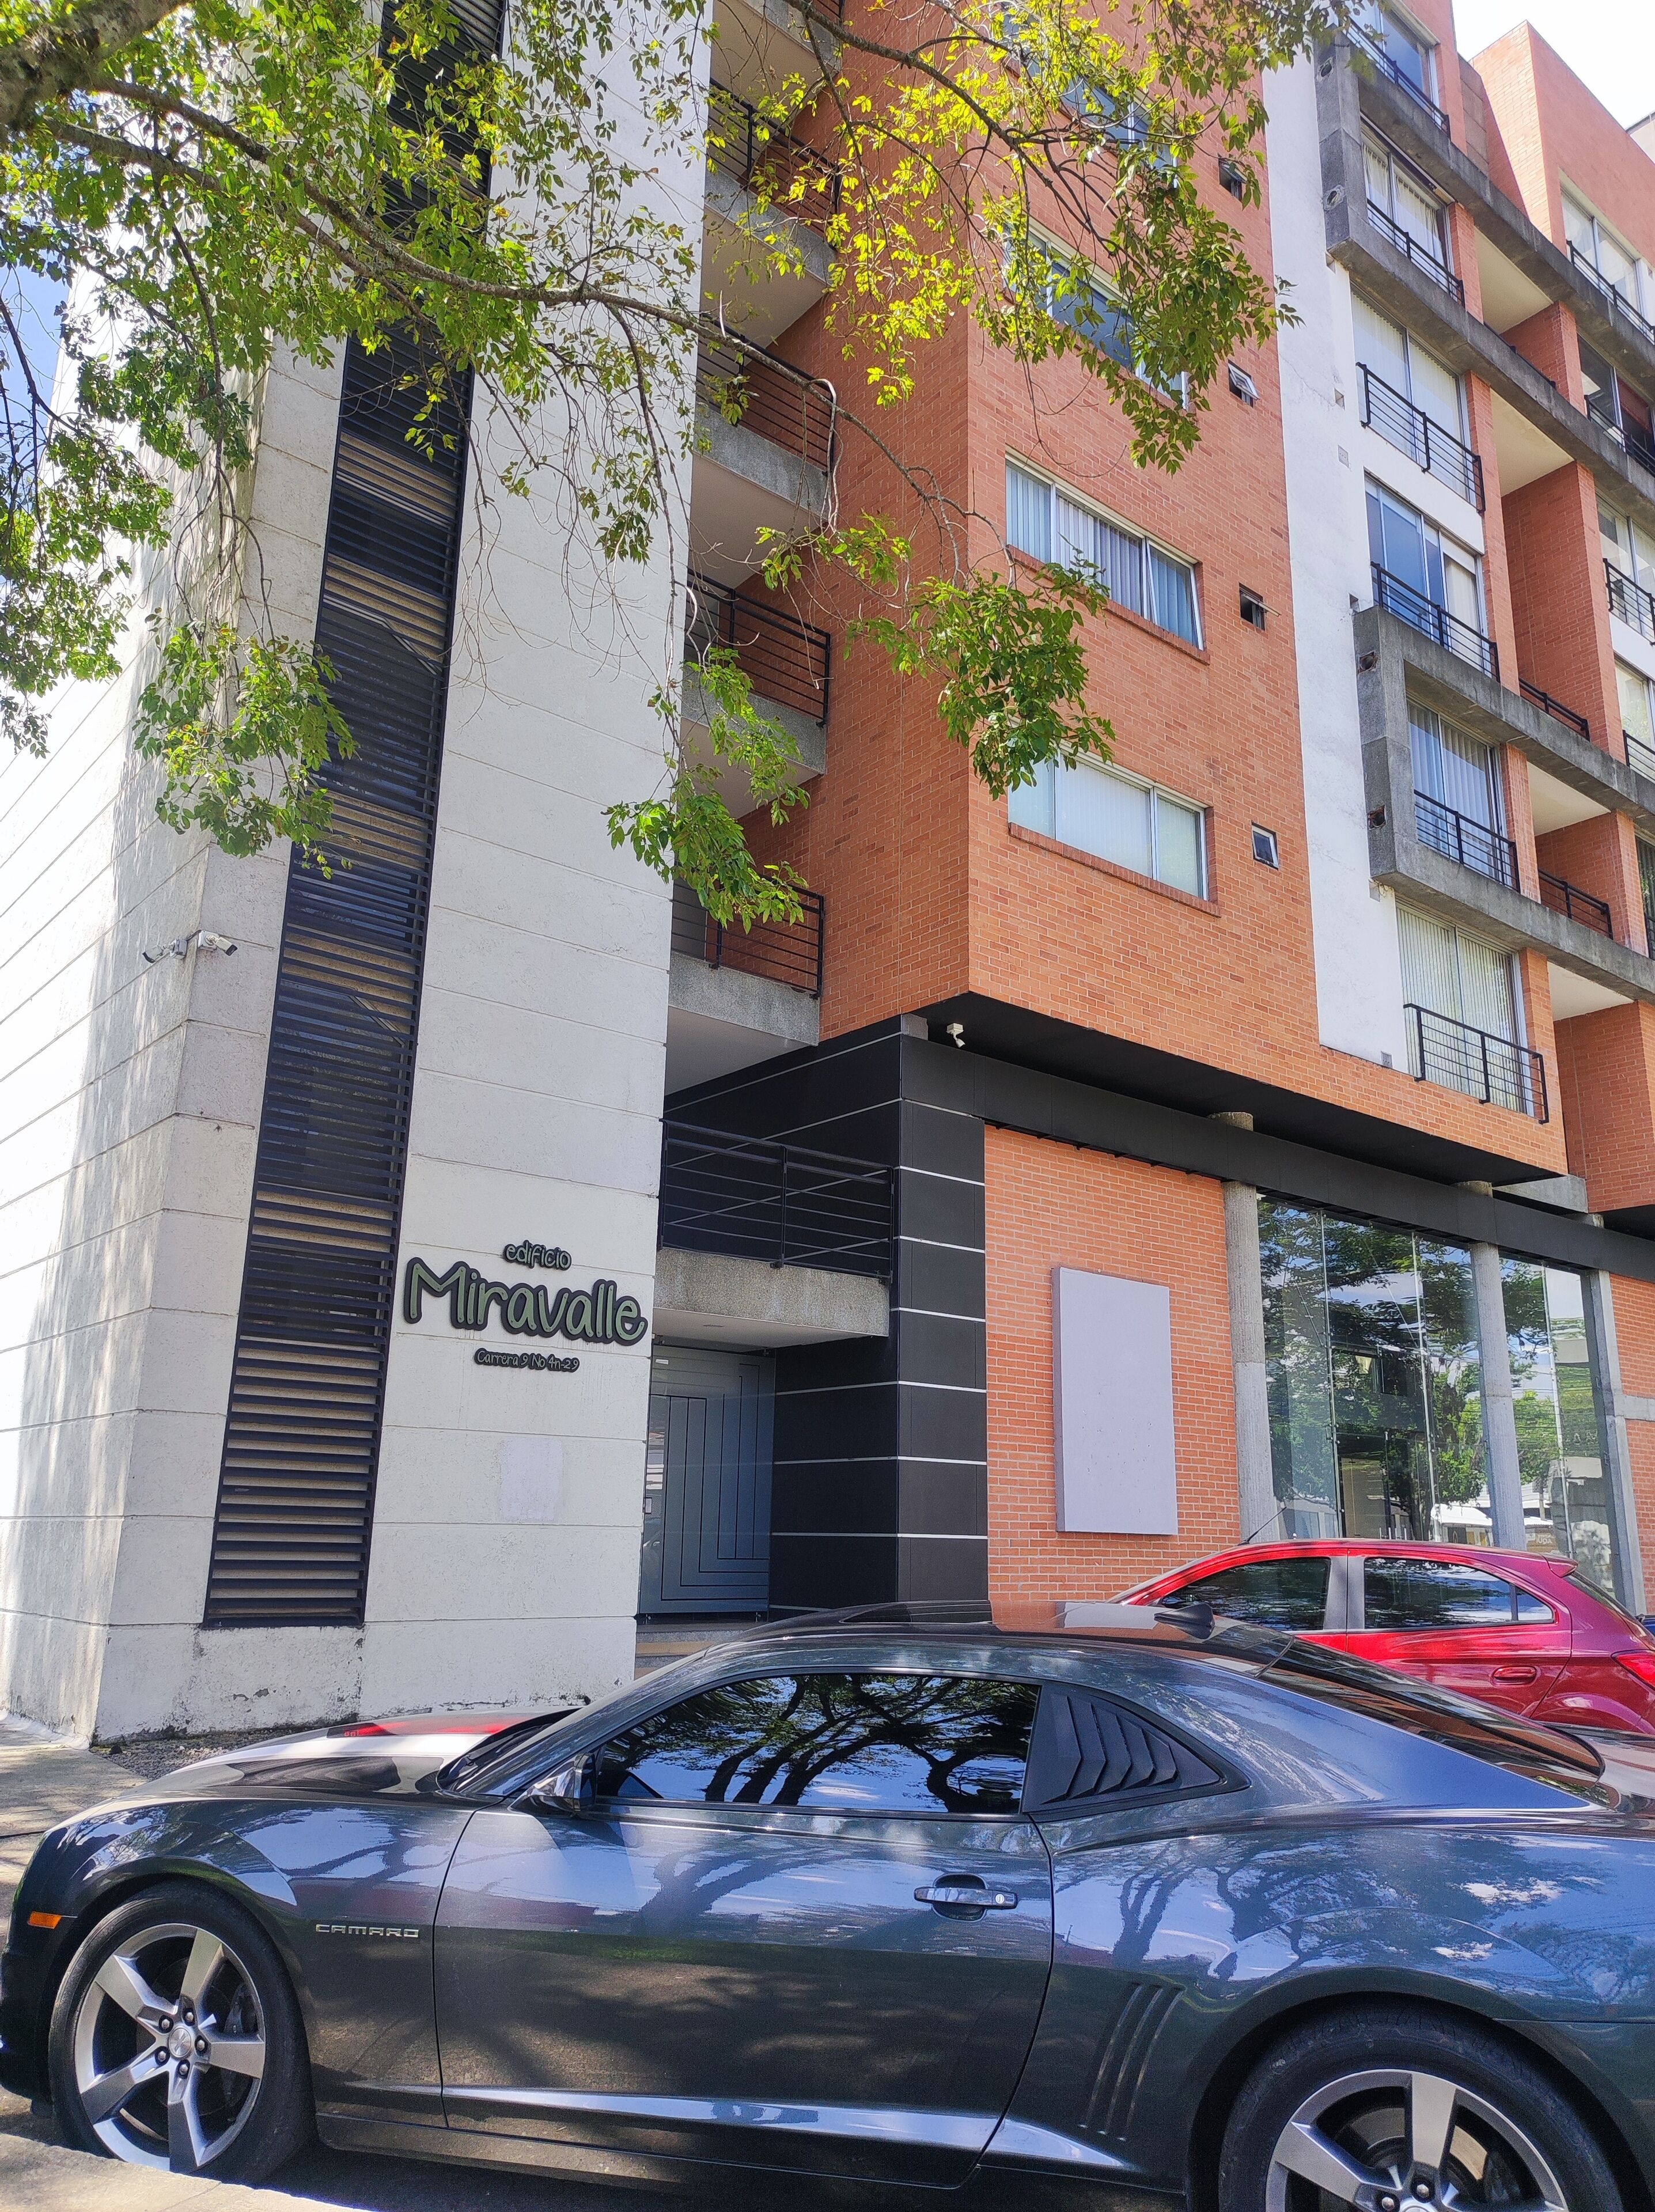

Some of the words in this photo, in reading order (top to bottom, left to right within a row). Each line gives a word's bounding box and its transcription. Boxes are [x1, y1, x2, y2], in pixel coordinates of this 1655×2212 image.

[505, 1241, 571, 1270] edificio
[408, 1262, 646, 1342] Miravalle
[476, 1350, 518, 1366] Carrera
[520, 1355, 529, 1366] 9
[531, 1355, 546, 1368] No
[315, 1923, 419, 1938] CAMARO
